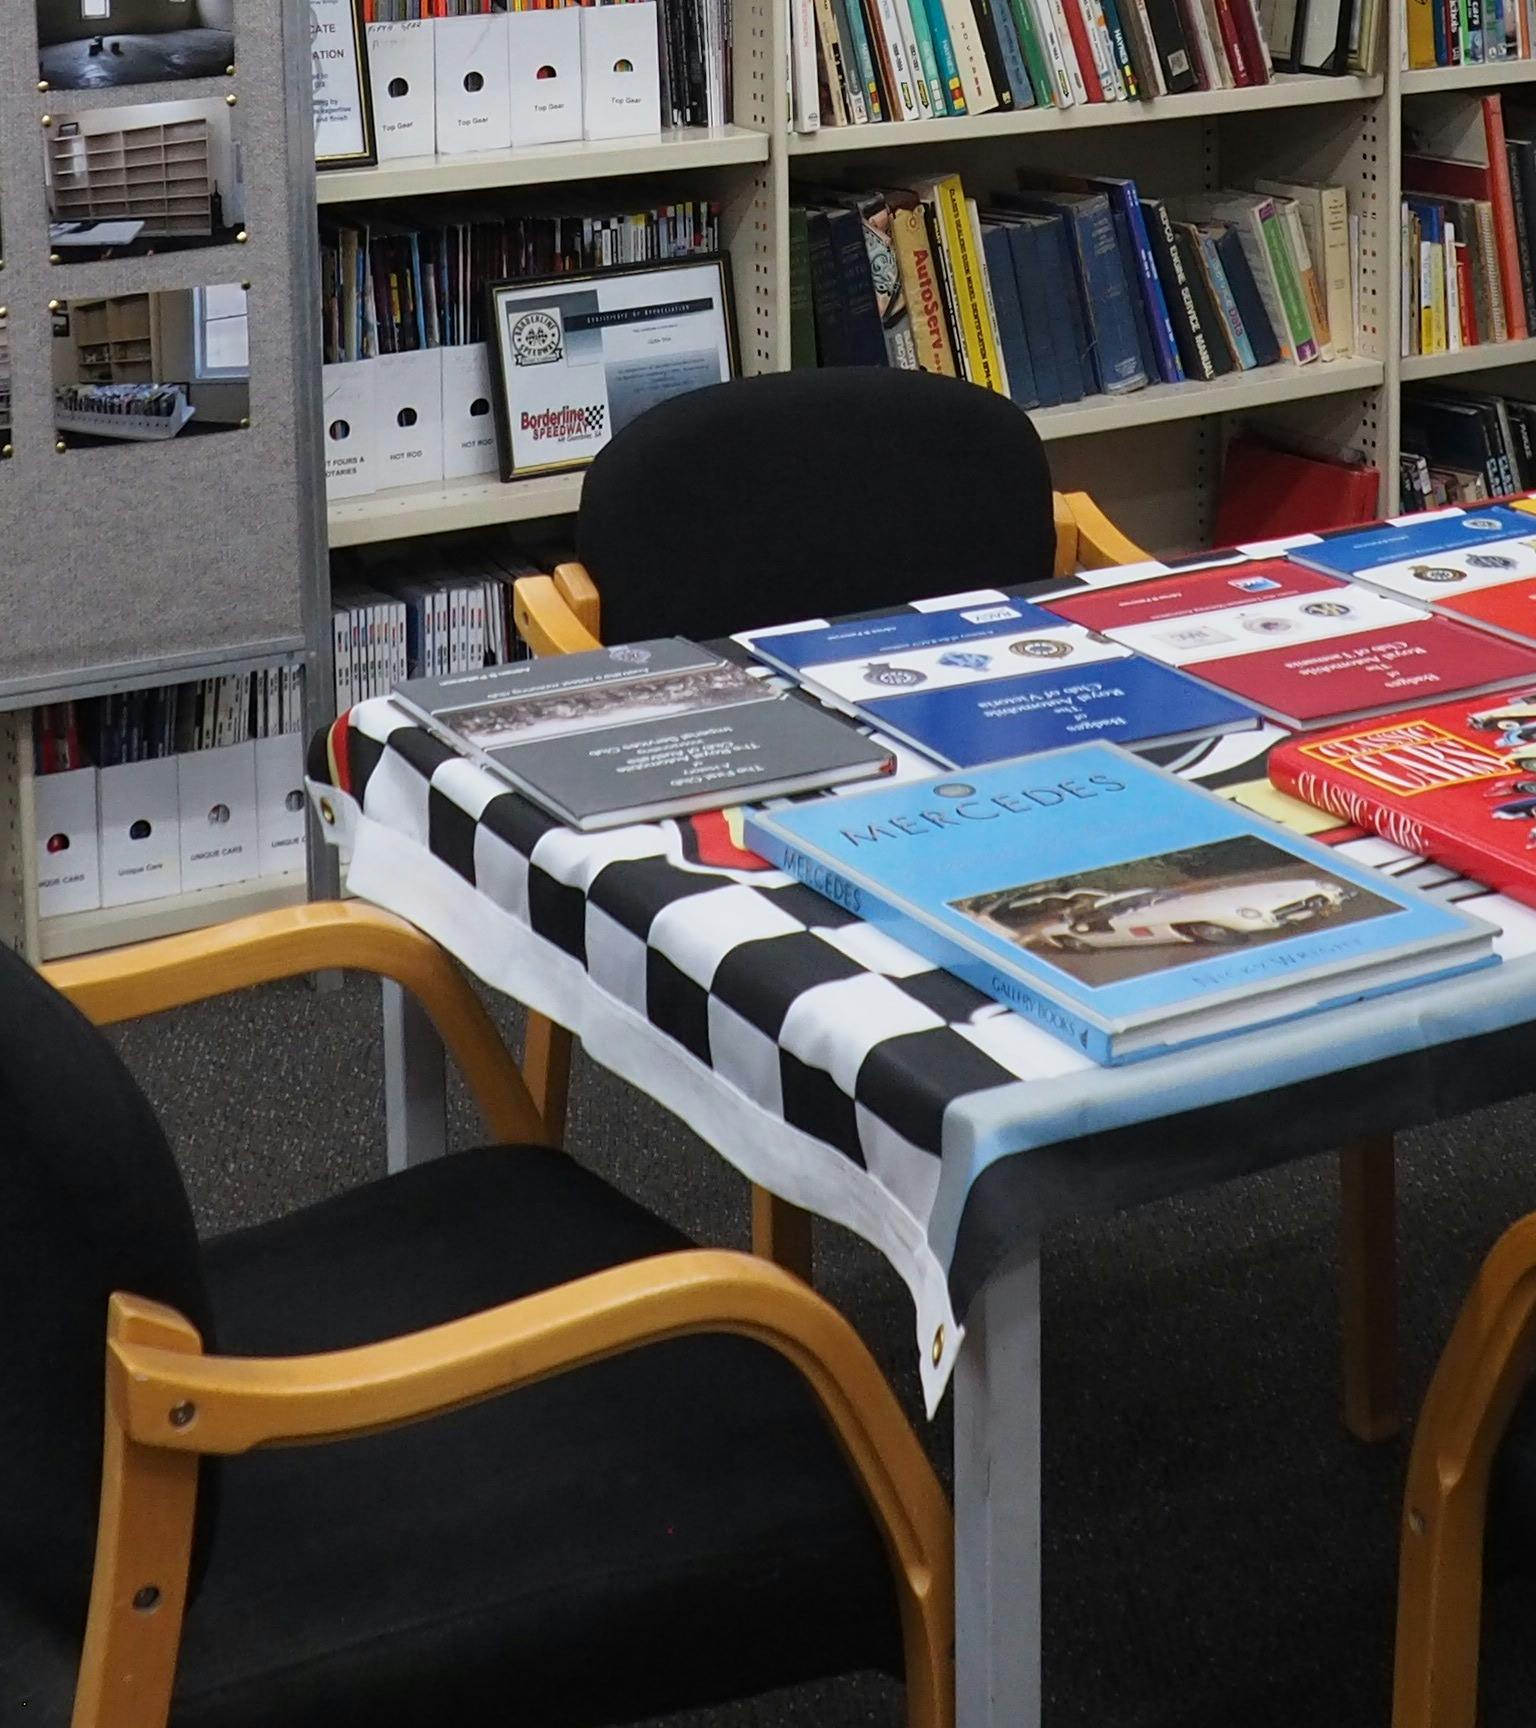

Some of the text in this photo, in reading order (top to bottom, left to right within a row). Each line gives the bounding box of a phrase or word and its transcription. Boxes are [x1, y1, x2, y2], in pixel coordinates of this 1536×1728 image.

[1471, 1, 1480, 26] cars
[1113, 29, 1129, 65] HAYNES
[534, 102, 565, 113] Top Gear
[611, 96, 642, 106] Top Gear
[382, 121, 414, 134] Top Gear
[457, 116, 489, 128] Top Gear
[913, 249, 945, 350] AutoServ
[1159, 206, 1215, 378] REPCO ENGINE SERVICE MANUAL
[514, 312, 556, 337] BORDERLINE
[965, 276, 987, 360] MODEL IDENTIFICATION
[1227, 306, 1244, 337] Data
[519, 340, 557, 356] SPEEDWAY
[521, 406, 585, 431] Borderline
[533, 422, 591, 441] SPEEDWAY
[461, 440, 476, 449] HOT
[333, 457, 358, 467] FOURS
[390, 452, 405, 461] HOT
[1371, 639, 1409, 652] Club
[1297, 645, 1428, 677] Royal Automobile
[1384, 671, 1441, 689] Badges
[977, 682, 1103, 709] Club of Victoria
[983, 686, 1126, 719] Royal Automobile
[1052, 704, 1083, 715] The
[1065, 716, 1127, 732] Badges
[732, 740, 760, 752] The
[1317, 725, 1436, 759] CLASSIC
[737, 764, 765, 774] The
[1349, 739, 1512, 790] CARS
[839, 772, 1129, 848] MERCEDES
[271, 837, 300, 849] UNIQUE
[190, 846, 243, 862] UNIQUE CARS
[62, 874, 86, 885] CARS
[782, 847, 865, 914] MERCEDES
[990, 974, 1076, 1039] GALLERY BOOKS
